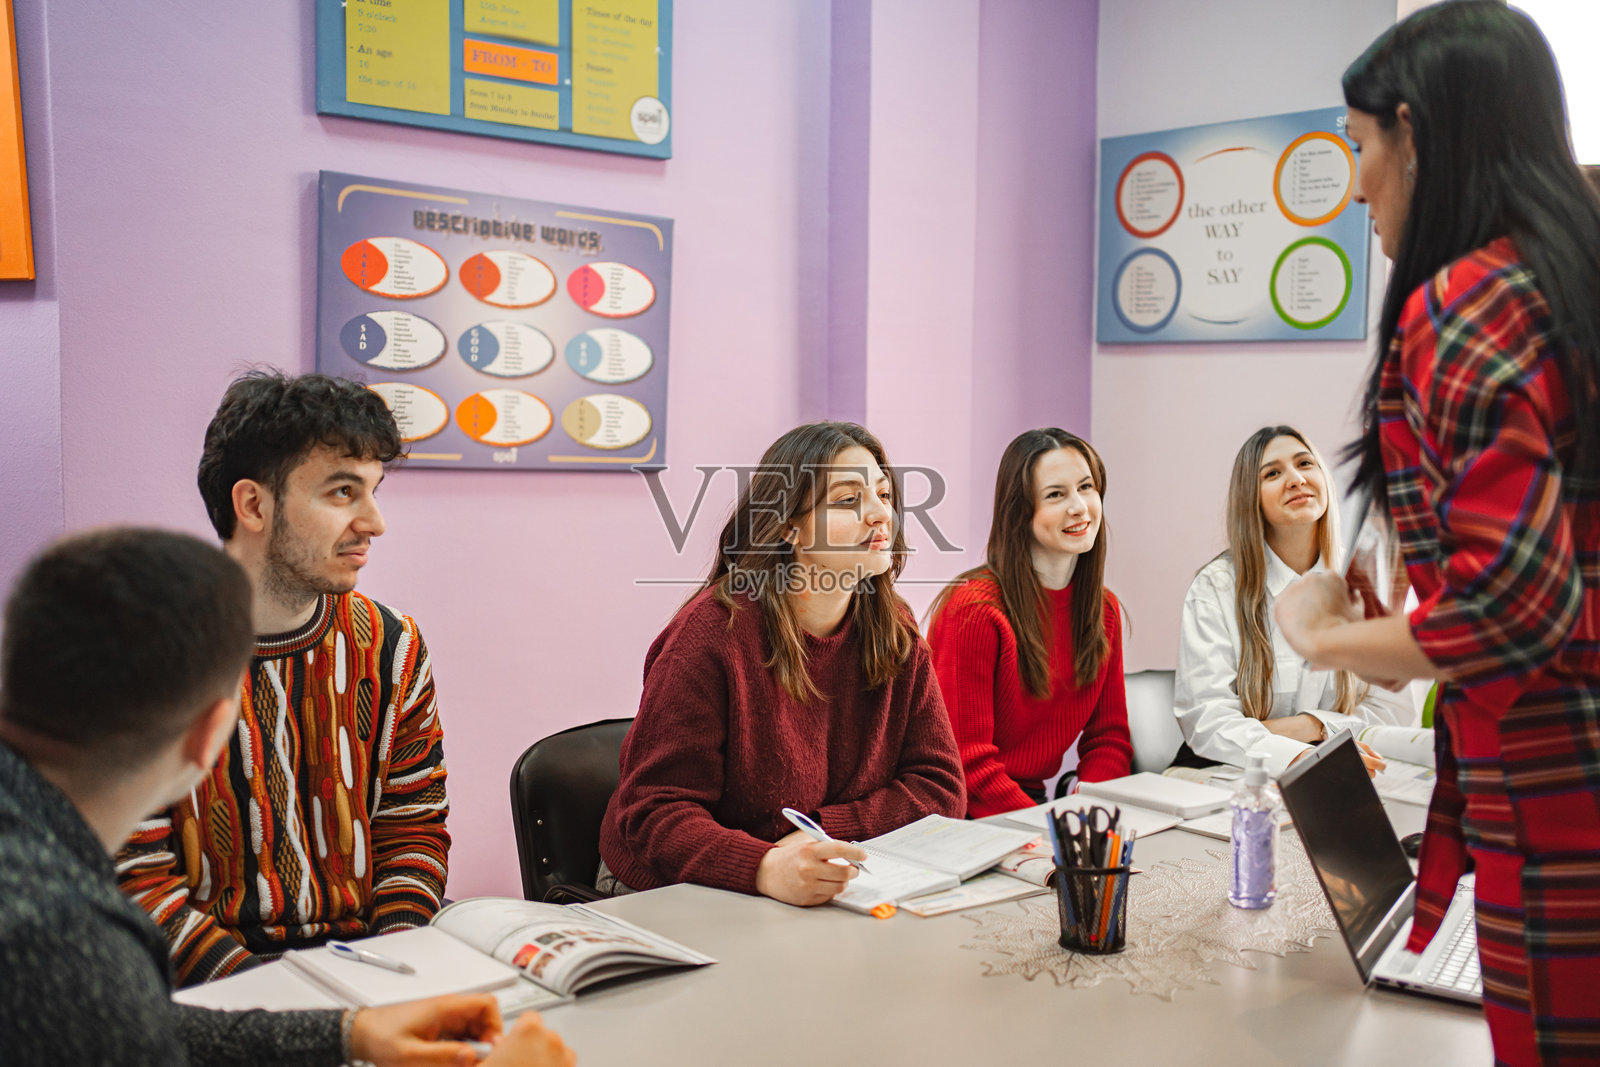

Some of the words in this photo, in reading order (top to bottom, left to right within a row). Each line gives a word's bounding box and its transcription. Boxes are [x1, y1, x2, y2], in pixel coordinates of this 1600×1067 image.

[357, 44, 373, 55] An
[472, 48, 517, 69] FROM
[532, 59, 552, 74] TO
[1188, 202, 1215, 219] the
[1220, 199, 1268, 216] other
[541, 224, 602, 249] words
[1205, 221, 1244, 239] WAY
[1217, 248, 1234, 261] to
[1207, 267, 1244, 285] SAY
[359, 323, 368, 351] SAD
[470, 328, 479, 362] GOOD
